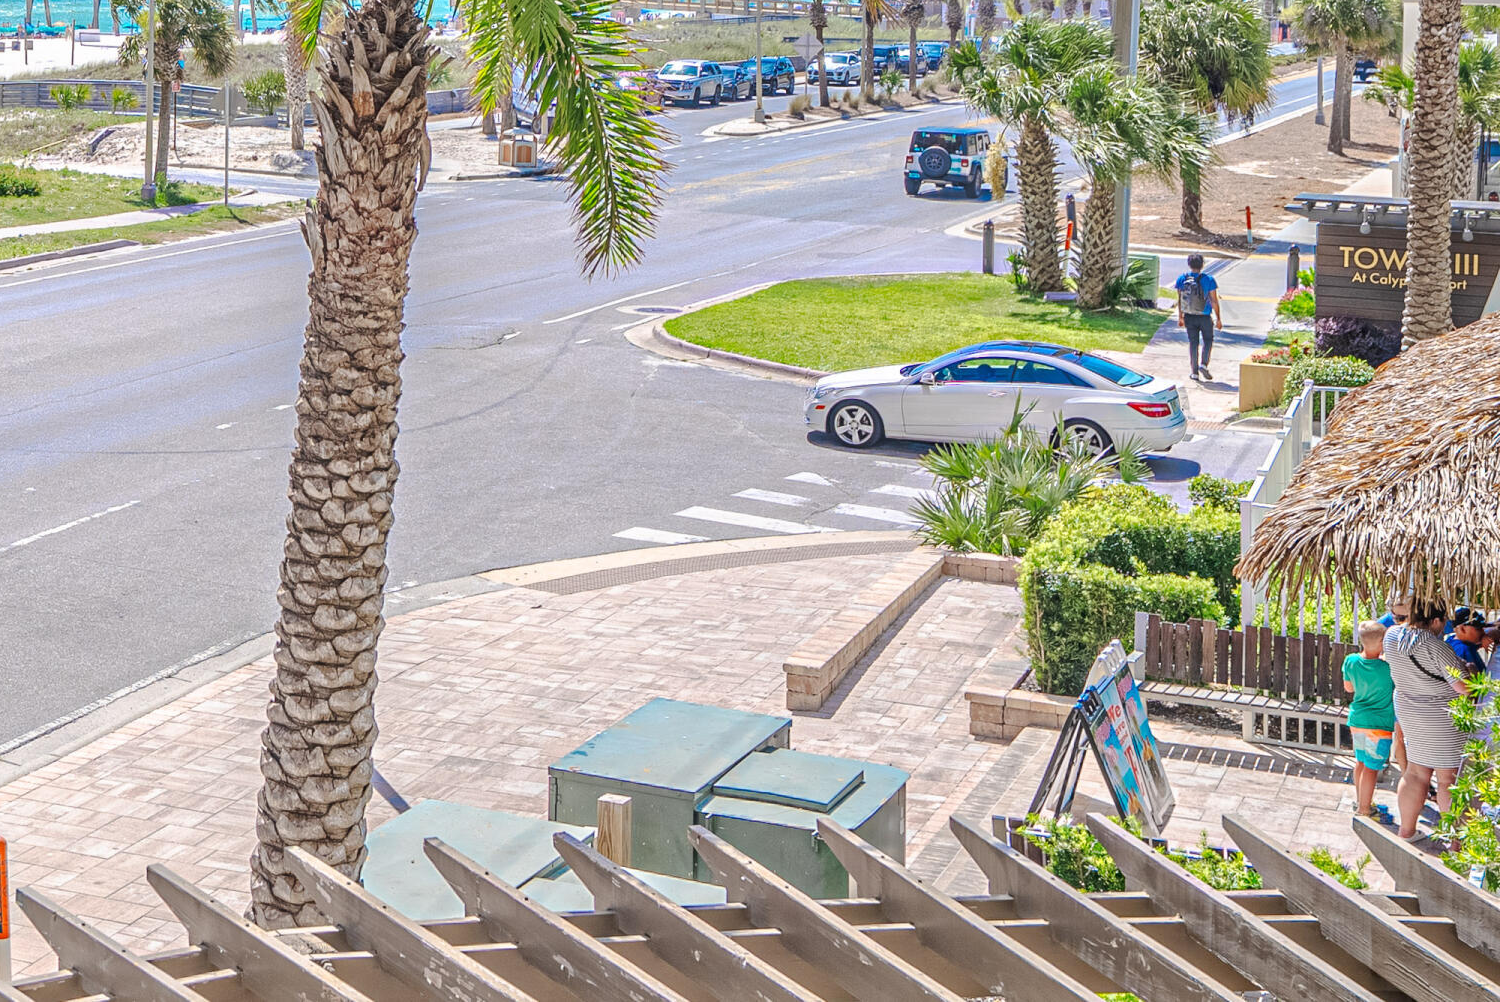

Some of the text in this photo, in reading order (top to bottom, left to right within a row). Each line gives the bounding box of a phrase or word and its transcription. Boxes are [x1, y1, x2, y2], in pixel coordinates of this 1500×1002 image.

[1339, 246, 1479, 276] TOW III
[1351, 272, 1367, 283] At
[1369, 273, 1407, 289] Calyp
